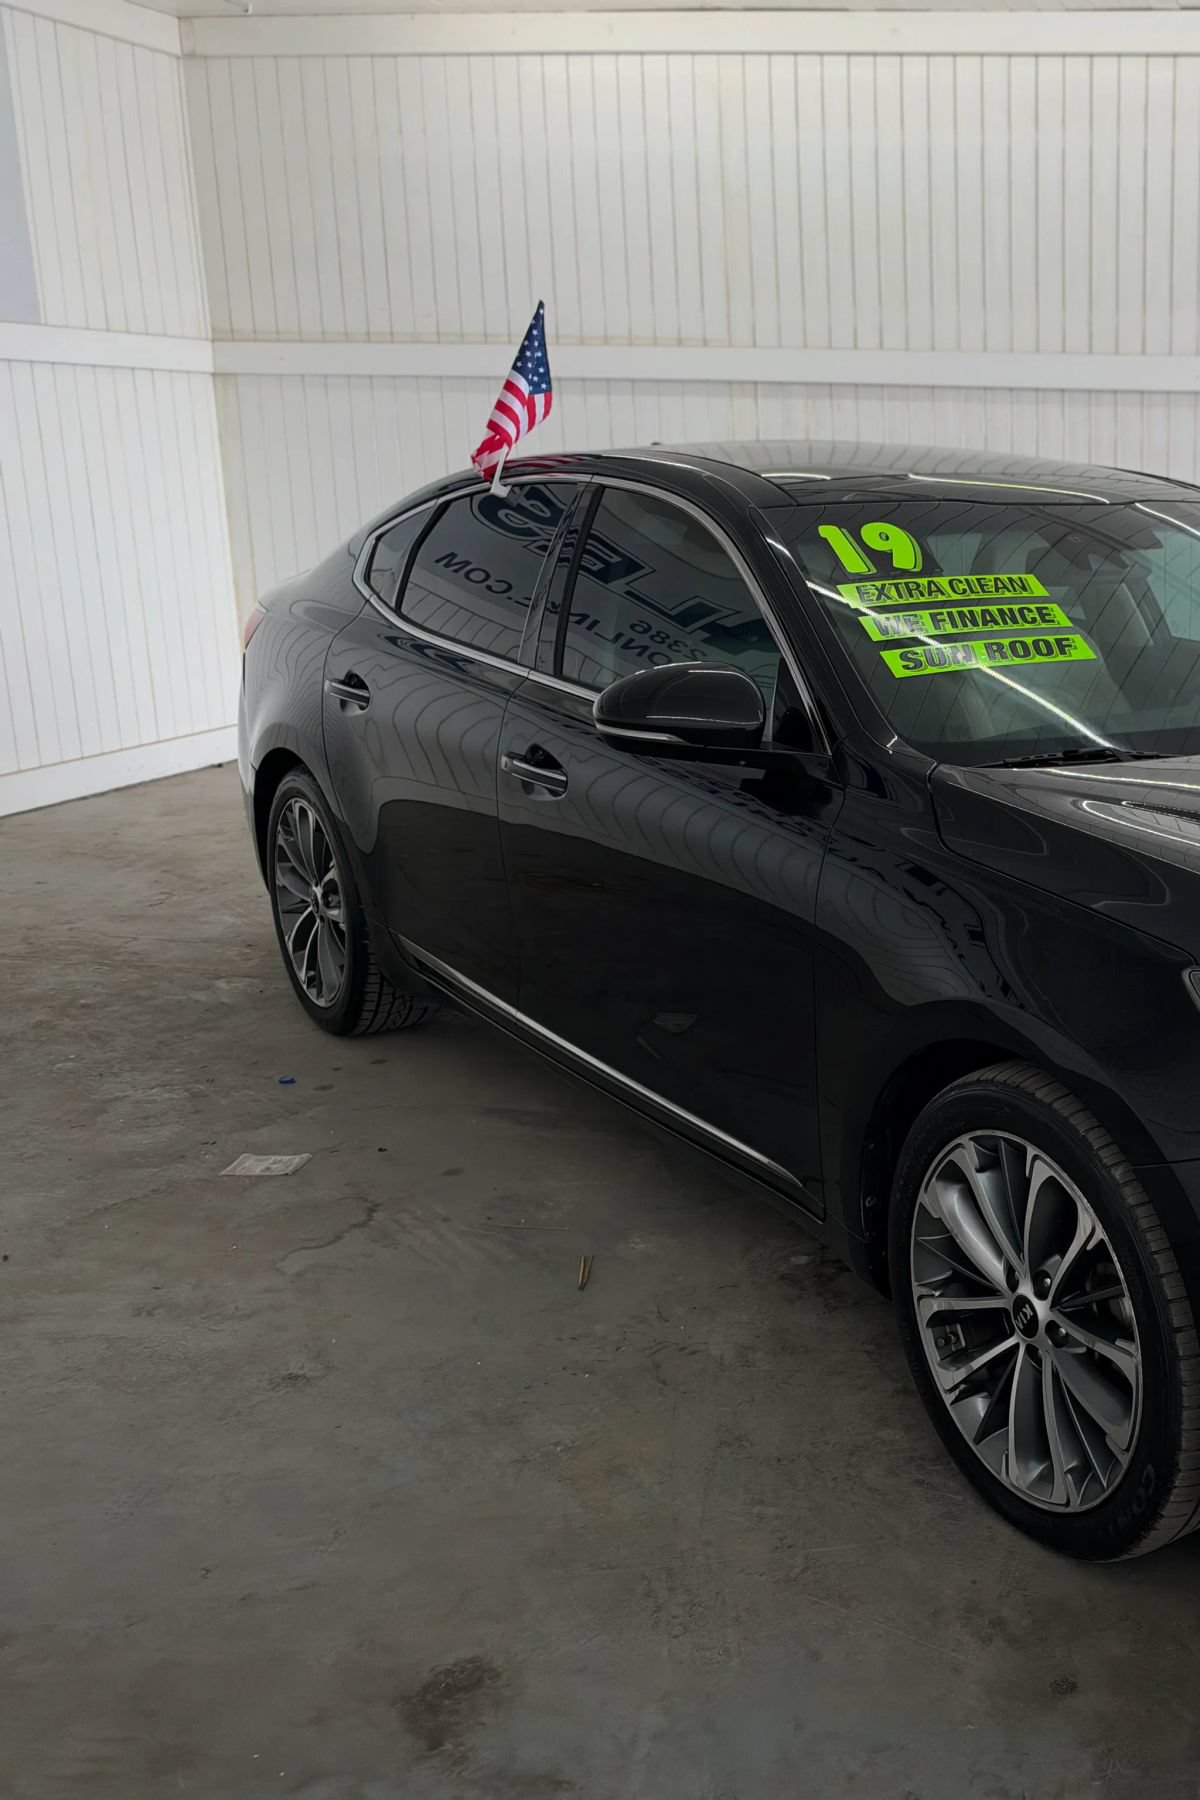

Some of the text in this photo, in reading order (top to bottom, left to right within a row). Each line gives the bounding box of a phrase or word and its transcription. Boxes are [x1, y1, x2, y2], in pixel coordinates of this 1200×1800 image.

[818, 522, 922, 574] 19
[855, 576, 1030, 604] EXTRA CLEAN
[872, 606, 1058, 637] WE FINANCE
[899, 636, 1079, 673] SUN ROOF
[1014, 1302, 1035, 1331] KIA
